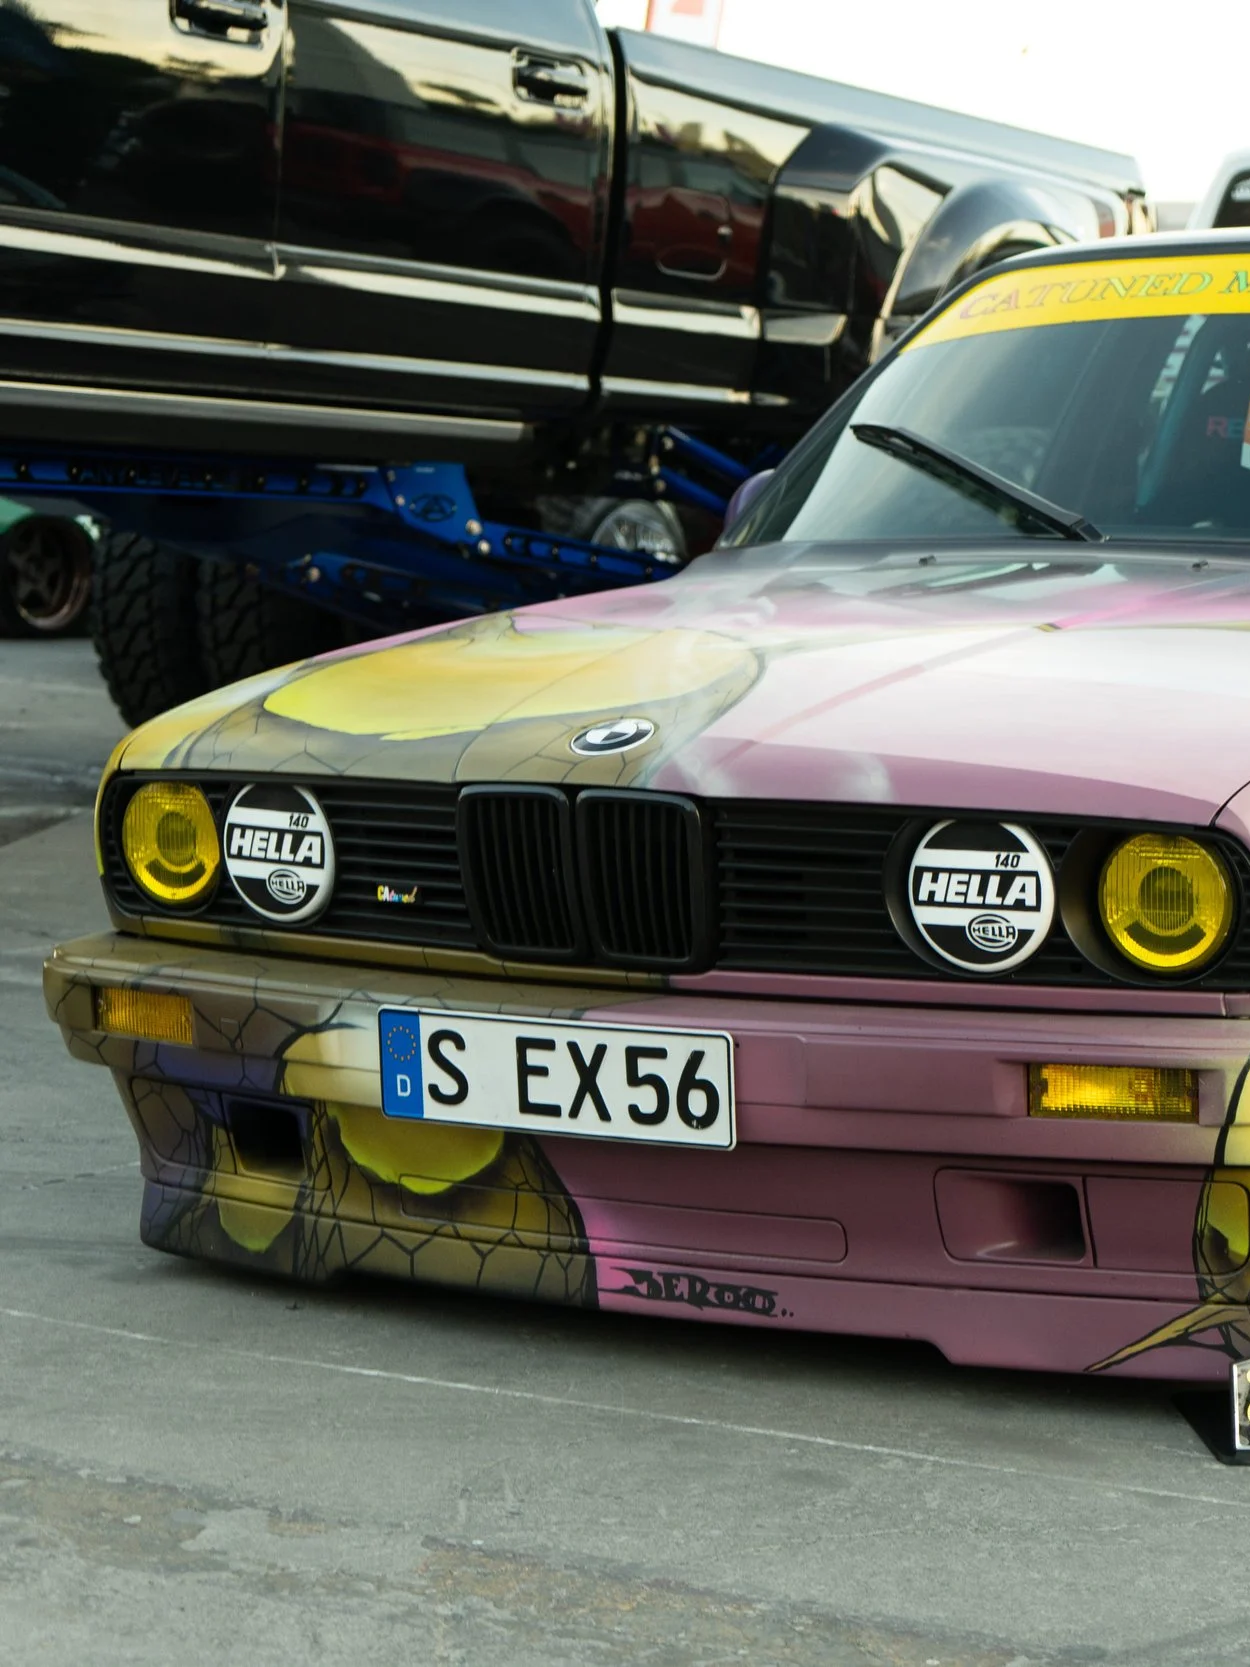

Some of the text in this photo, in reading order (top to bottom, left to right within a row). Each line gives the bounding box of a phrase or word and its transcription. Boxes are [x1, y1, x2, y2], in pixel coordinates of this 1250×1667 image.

[959, 270, 1213, 320] CATUNED
[289, 814, 310, 829] 140
[229, 827, 322, 865] HELLA
[994, 853, 1021, 869] 140
[271, 880, 306, 893] HELLA
[918, 872, 1038, 907] HELLA
[972, 923, 1016, 942] HELLA
[427, 1029, 469, 1105] S
[396, 1074, 411, 1097] D
